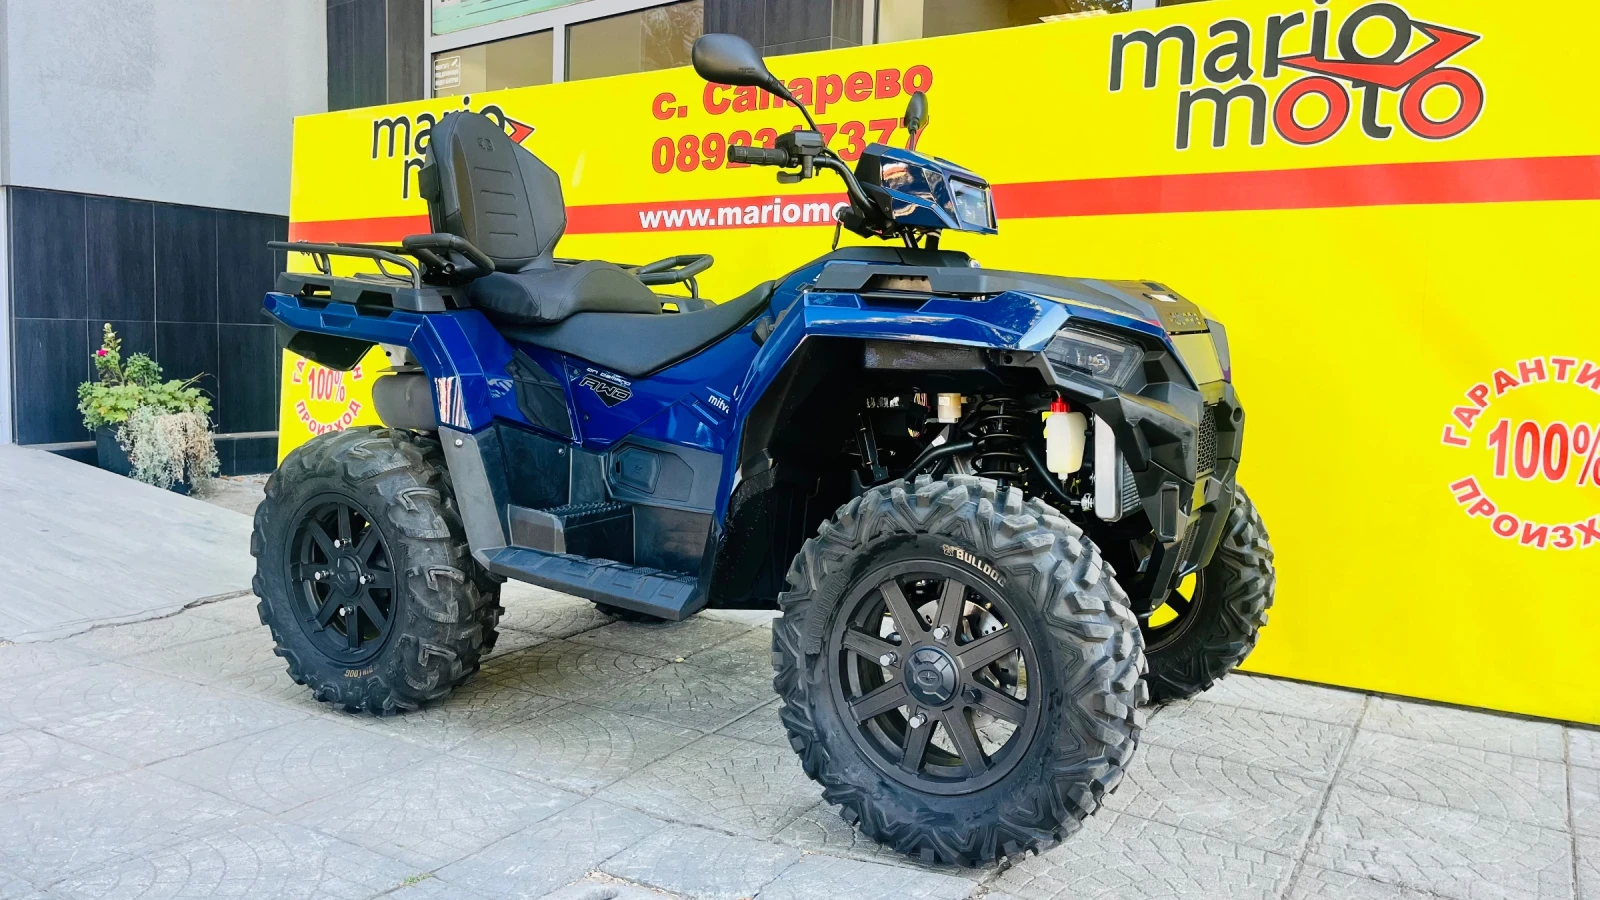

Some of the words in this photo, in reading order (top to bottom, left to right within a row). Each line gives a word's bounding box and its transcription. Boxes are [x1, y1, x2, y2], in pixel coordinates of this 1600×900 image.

[1109, 0, 1412, 91] mario
[652, 92, 688, 120] с.
[702, 65, 933, 115] Сапарево
[1175, 67, 1484, 150] moto
[309, 367, 345, 402] 100%
[579, 376, 632, 401] AWD
[956, 548, 1007, 588] BULLDOG
